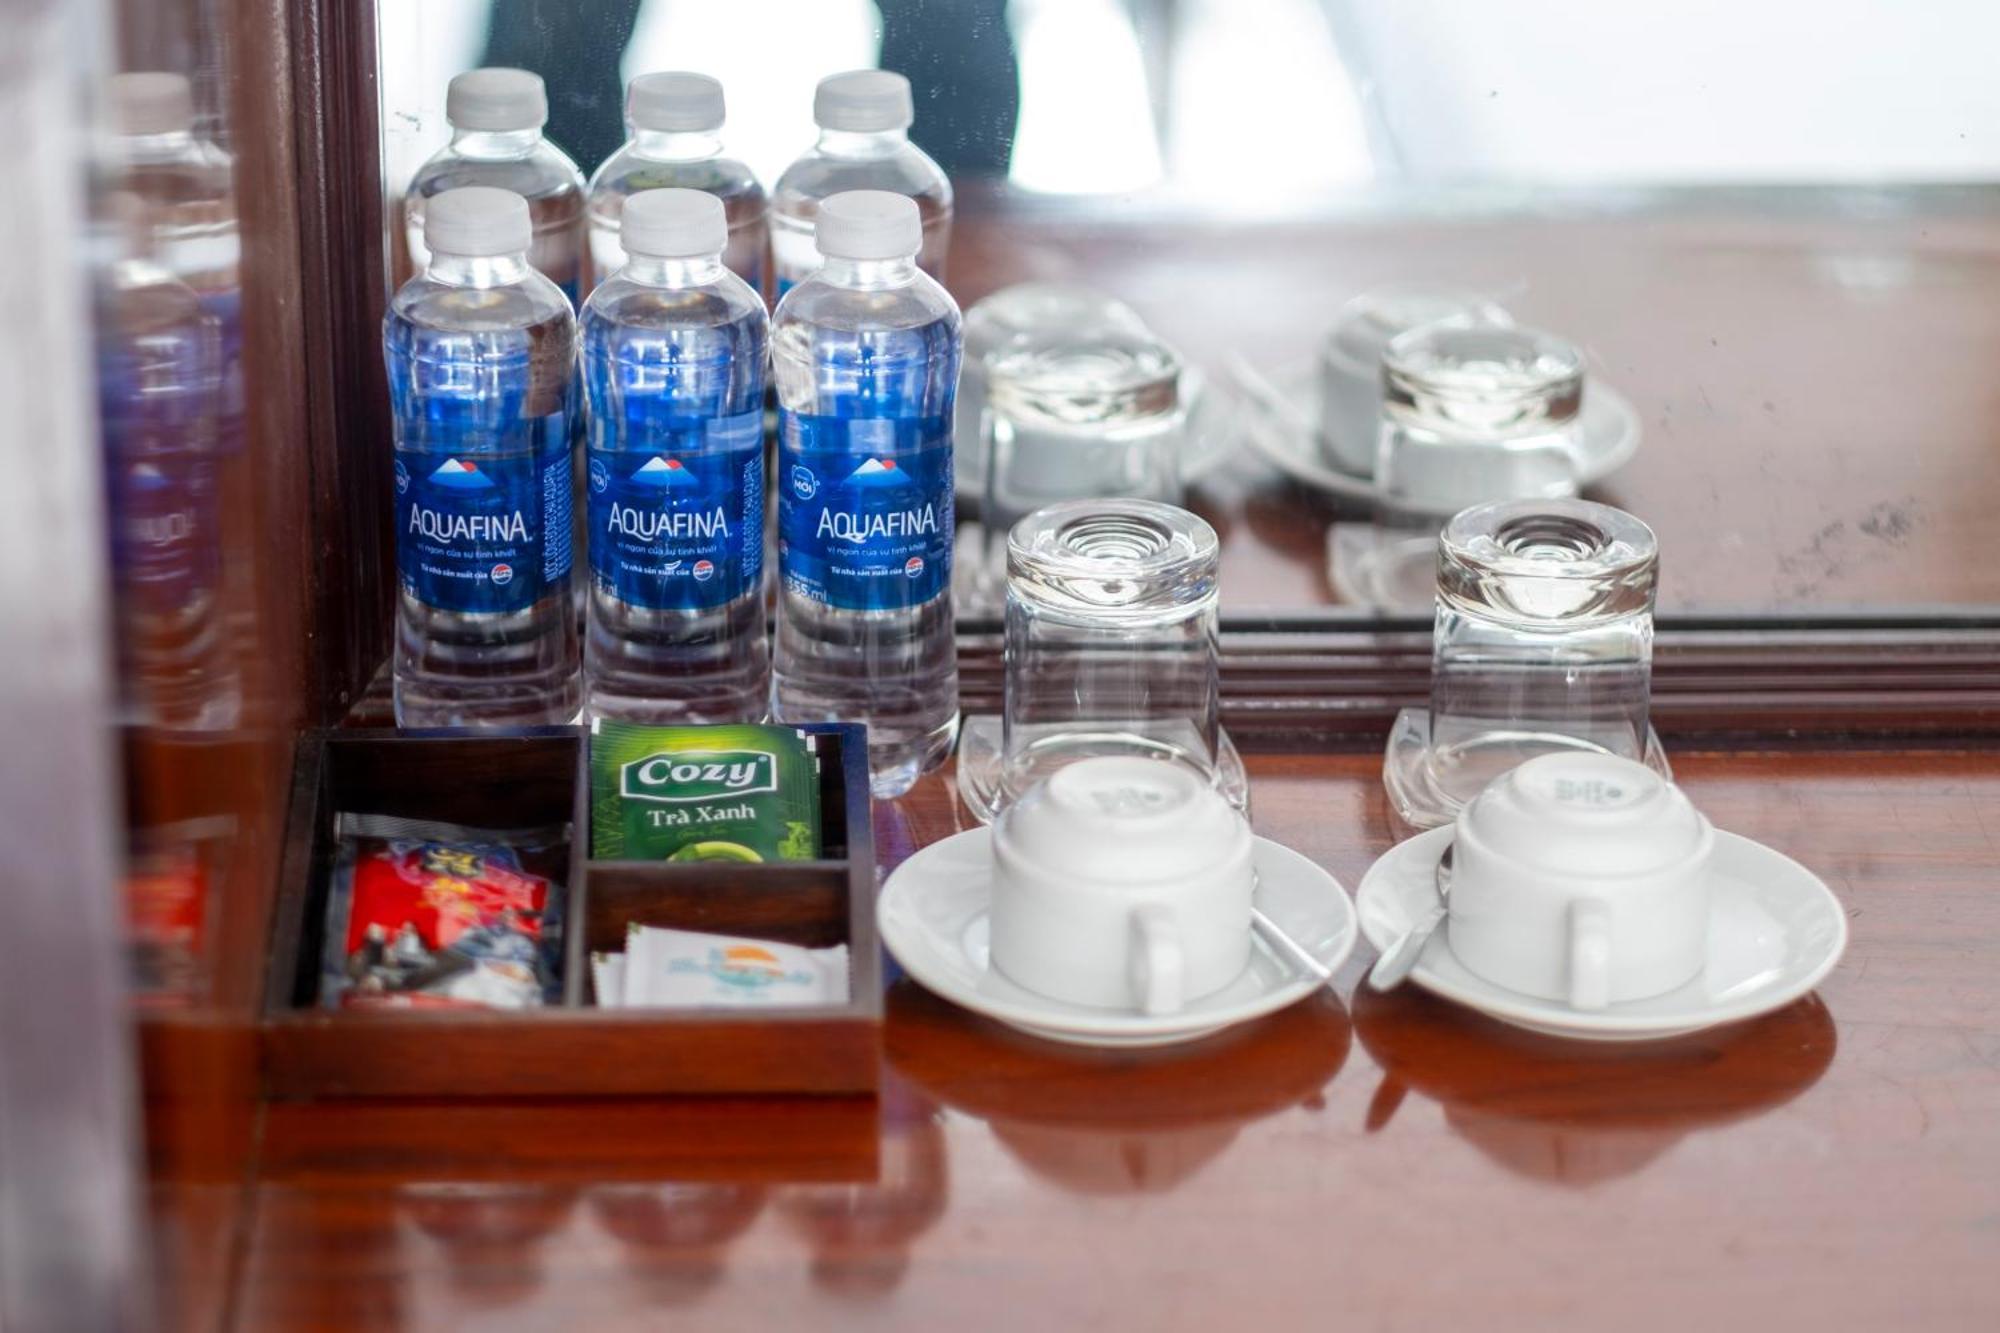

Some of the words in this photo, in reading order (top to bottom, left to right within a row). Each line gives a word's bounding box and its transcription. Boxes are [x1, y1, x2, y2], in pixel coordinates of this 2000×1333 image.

[409, 502, 529, 543] AQUAFINA
[608, 501, 729, 542] AQUAFINA
[816, 502, 936, 544] AQUAFINA
[637, 758, 758, 787] Cozy
[647, 807, 691, 827] Trà
[696, 803, 756, 823] Xanh
